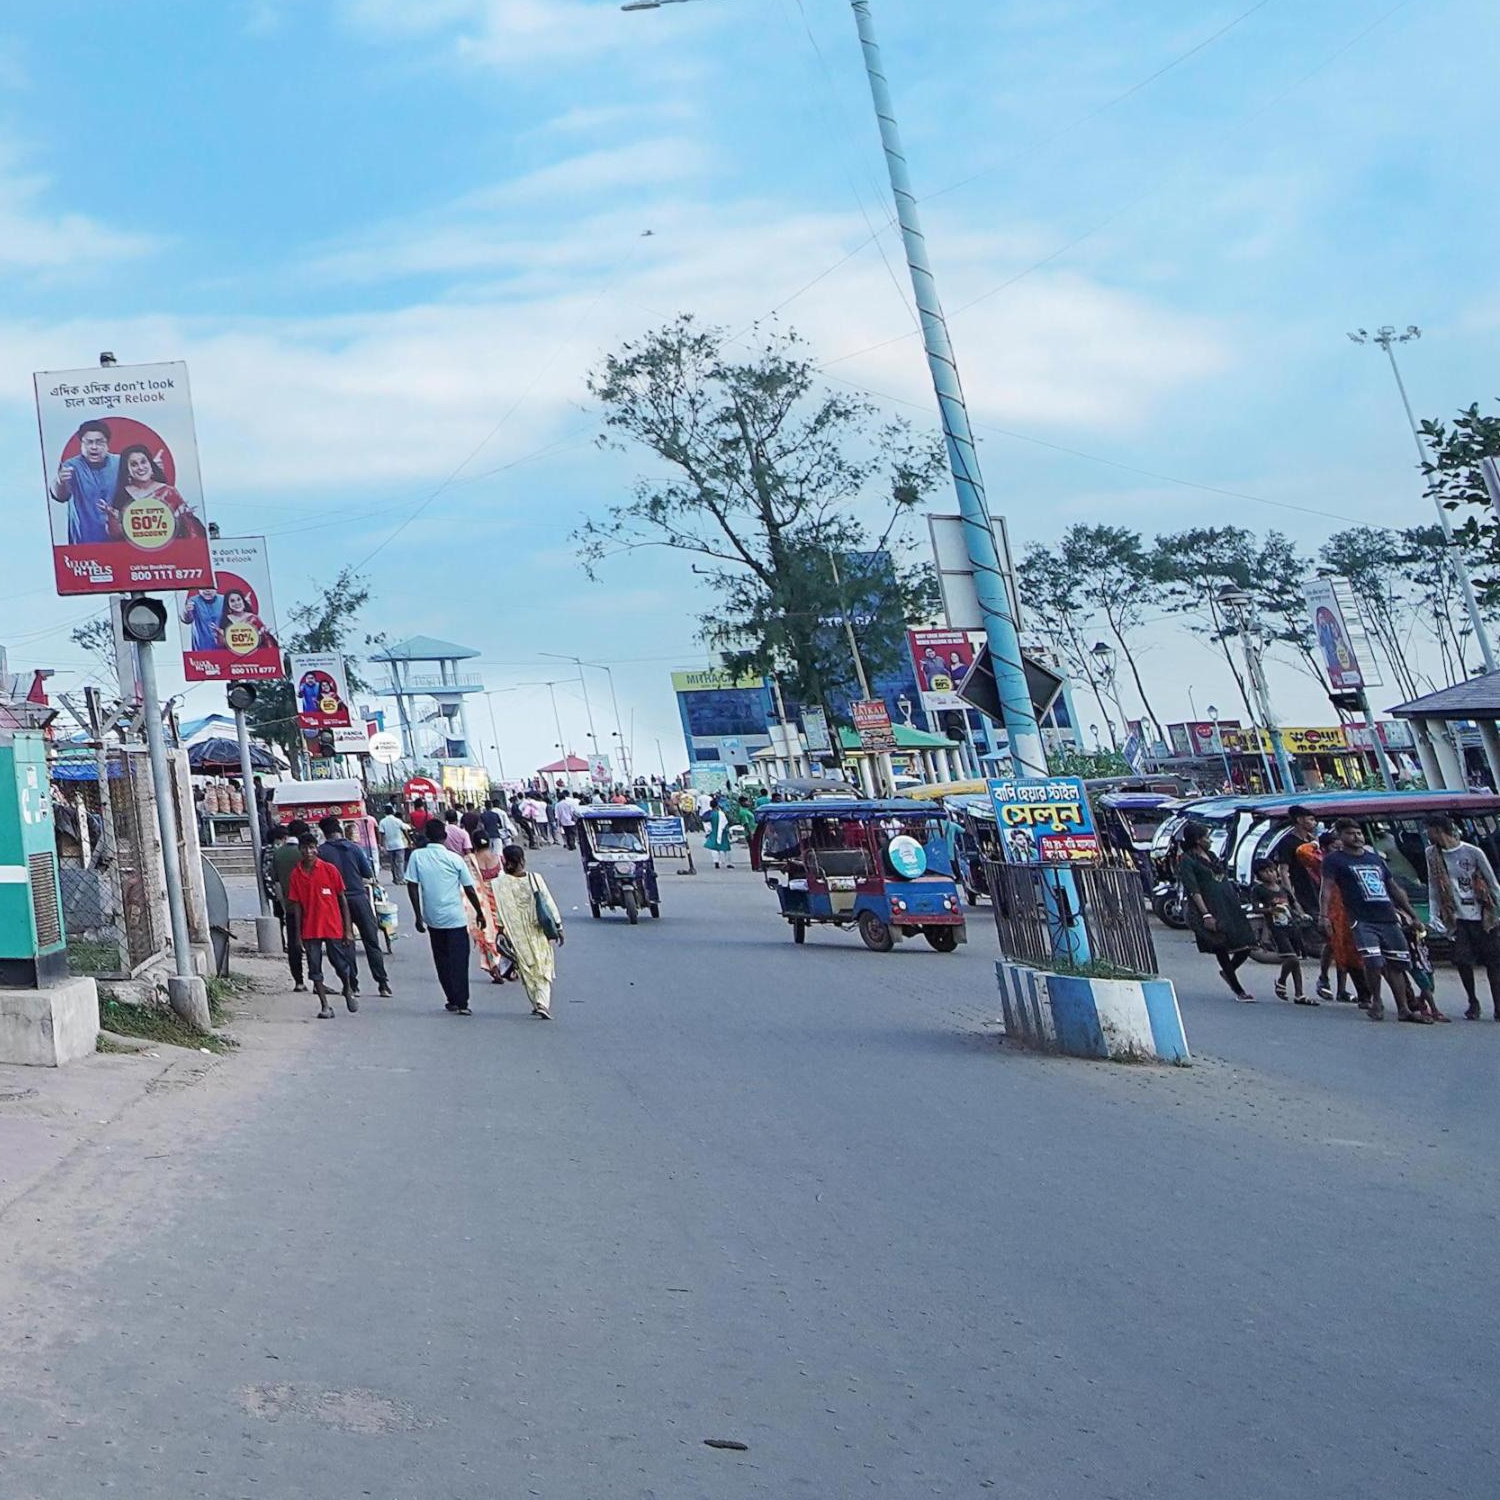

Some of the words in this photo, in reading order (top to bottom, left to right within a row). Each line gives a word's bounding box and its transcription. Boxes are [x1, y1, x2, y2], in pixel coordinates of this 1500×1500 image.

[149, 378, 175, 390] look
[125, 392, 166, 403] Relook
[131, 515, 168, 530] 60%
[130, 571, 152, 581] 800
[153, 570, 173, 580] 111
[175, 568, 203, 579] 8777
[993, 783, 1016, 801] বাপি
[1001, 802, 1081, 832] সেলুন
